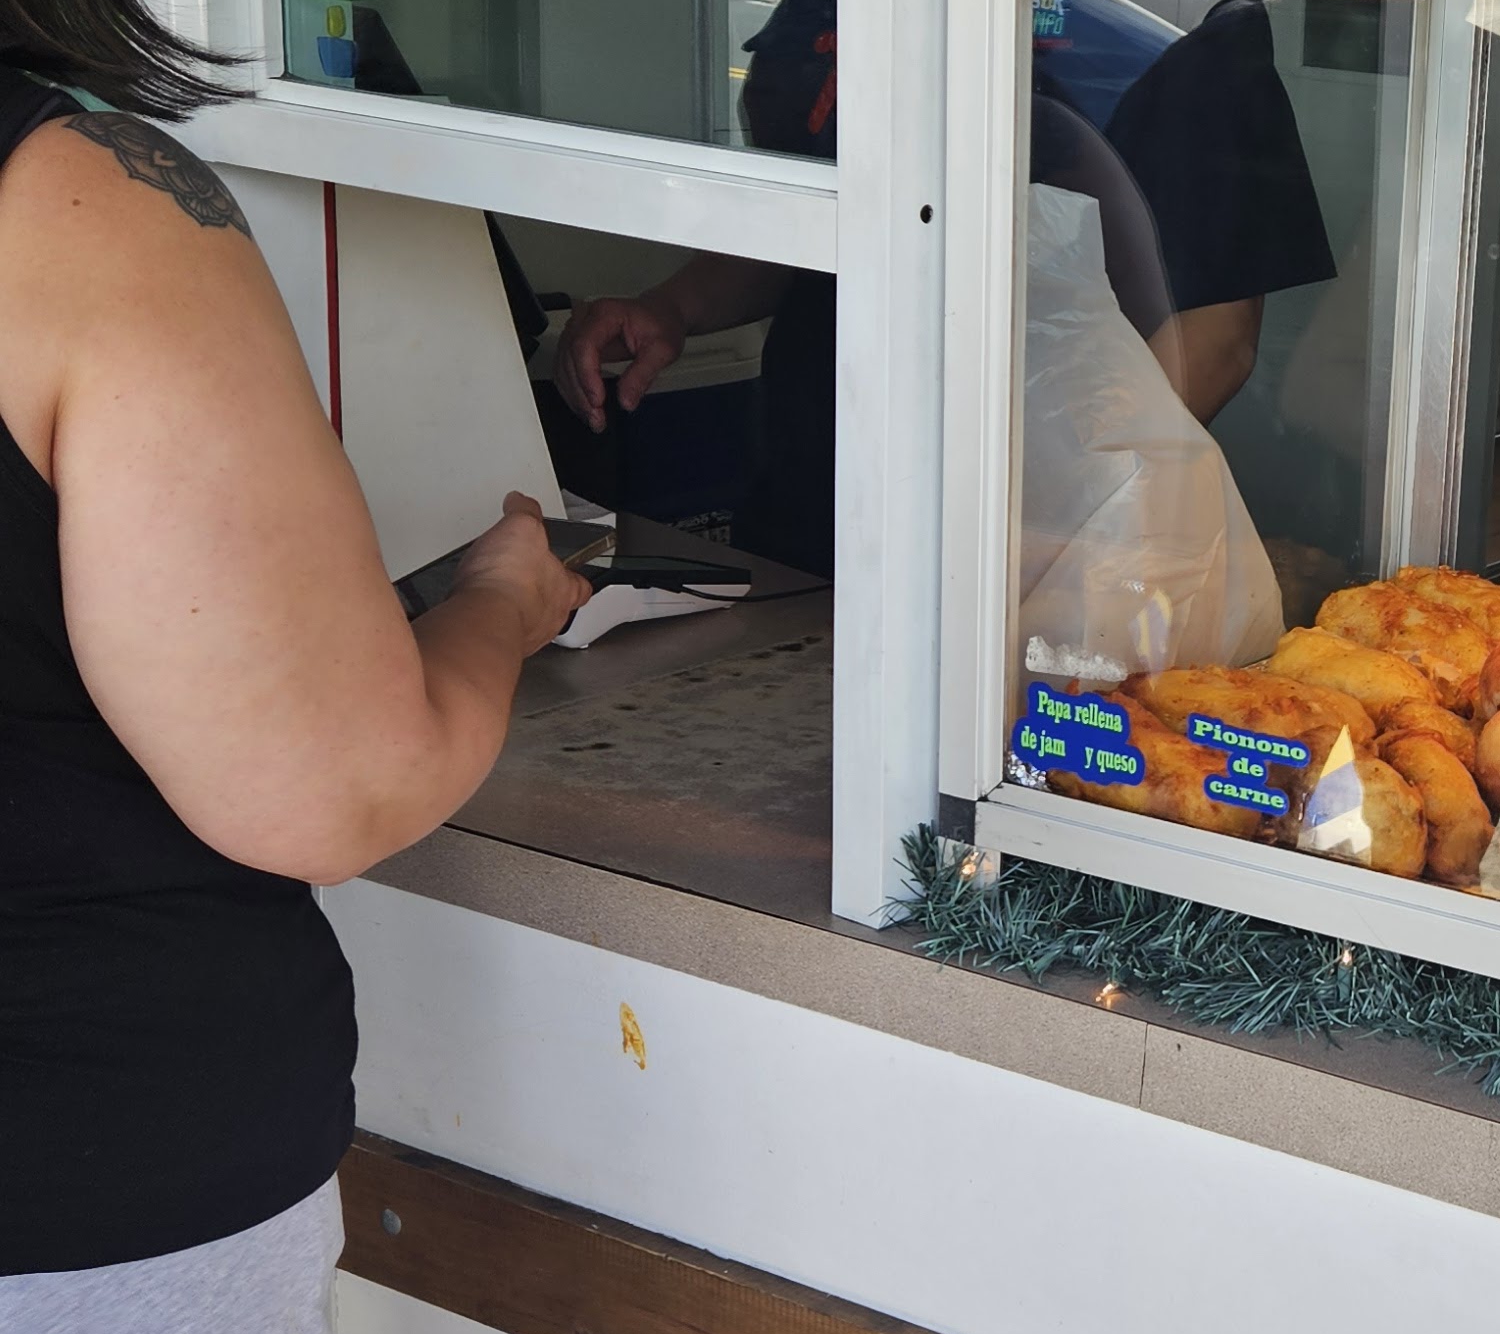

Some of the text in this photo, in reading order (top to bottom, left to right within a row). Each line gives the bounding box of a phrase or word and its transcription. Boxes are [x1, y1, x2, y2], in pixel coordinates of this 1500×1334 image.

[1037, 690, 1123, 734] Papa rellena
[1020, 726, 1138, 775] de jam y queso
[1193, 718, 1307, 762] Pionono
[1232, 758, 1264, 778] de
[1209, 780, 1286, 809] carne
